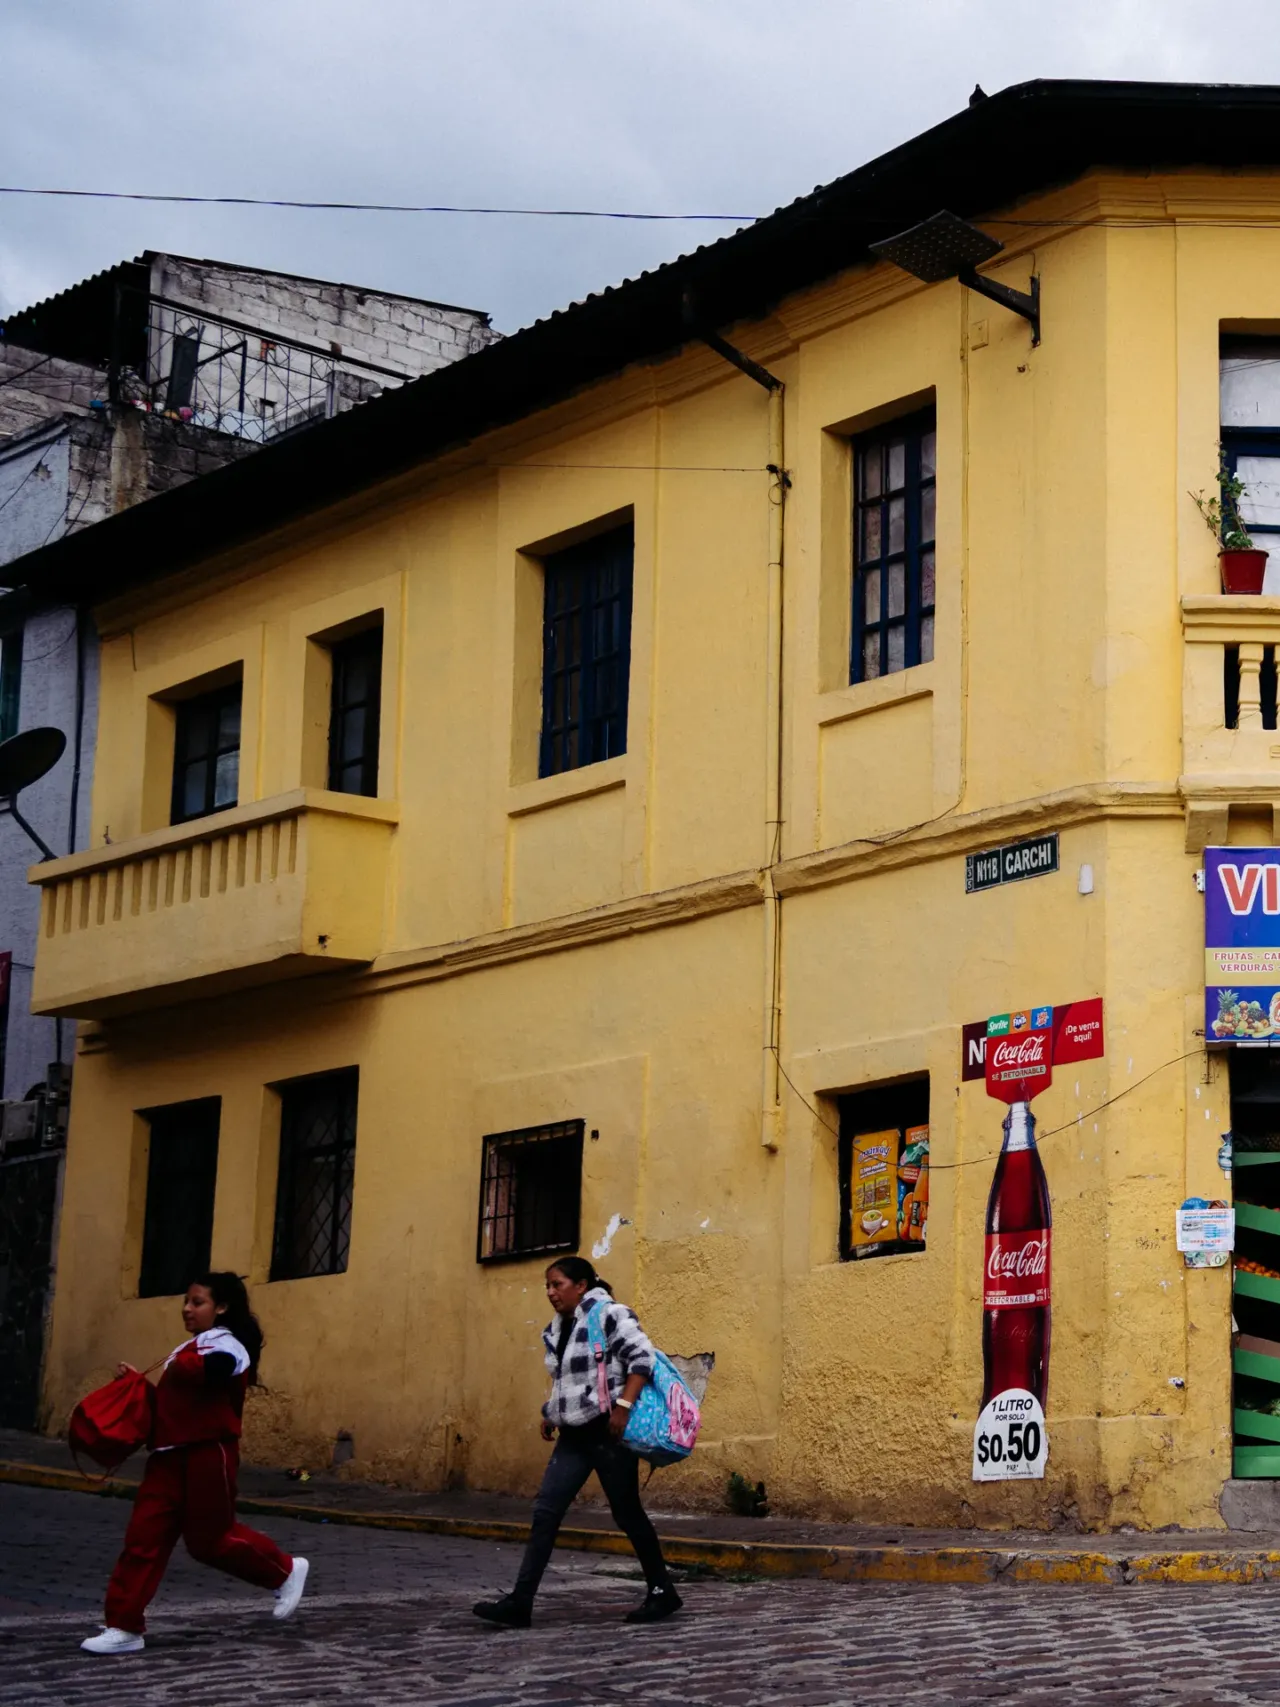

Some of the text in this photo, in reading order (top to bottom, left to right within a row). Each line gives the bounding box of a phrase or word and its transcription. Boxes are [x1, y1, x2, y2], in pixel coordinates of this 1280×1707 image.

[977, 843, 1051, 882] N11B CARCHI
[1214, 952, 1254, 961] FRUTAS
[1220, 963, 1274, 972] VERDURAS
[988, 1020, 1009, 1033] Sprite
[1065, 1021, 1100, 1035] ¡De venta
[1073, 1031, 1092, 1043] aquí!
[993, 1035, 1046, 1067] Coca-Cola
[987, 1238, 1048, 1279] Coca-Cola
[989, 1295, 1031, 1304] RETORNABLE
[992, 1399, 1033, 1412] 1 LITRO
[977, 1421, 1041, 1467] $0.50
